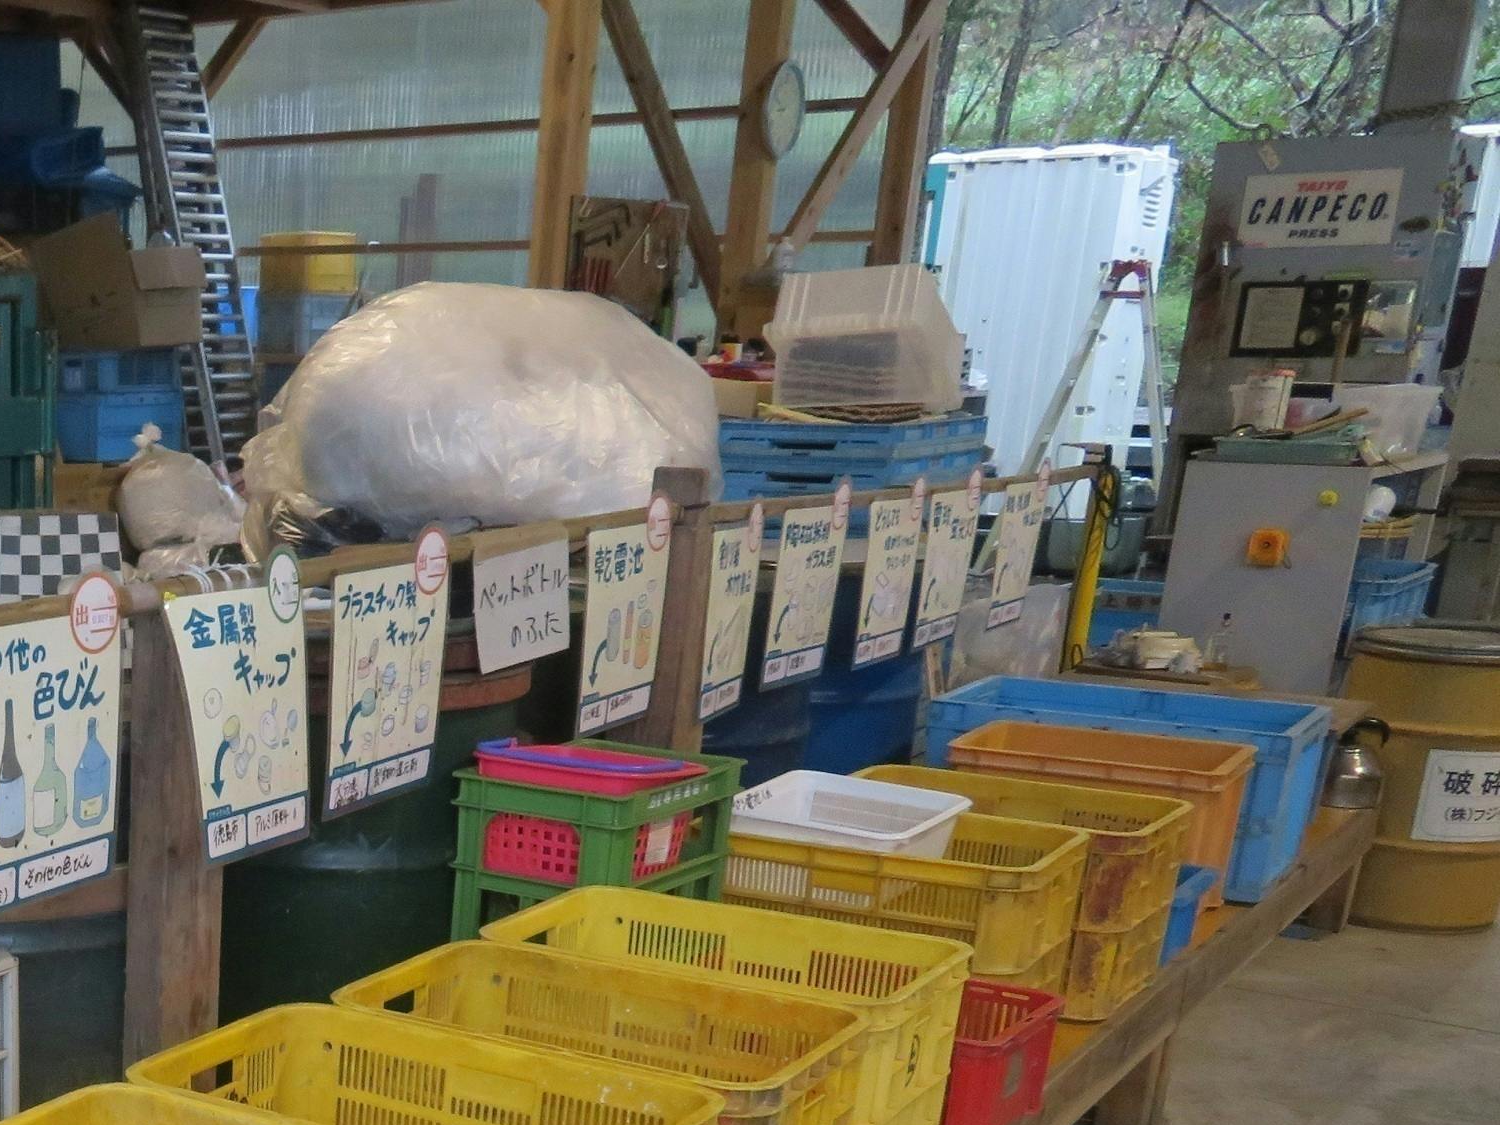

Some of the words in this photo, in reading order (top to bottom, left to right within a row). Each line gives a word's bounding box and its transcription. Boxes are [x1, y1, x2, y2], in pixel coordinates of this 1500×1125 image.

[1247, 192, 1389, 224] CANPECO
[594, 542, 644, 583] 乾電池
[340, 580, 417, 620] プラスチック製
[479, 563, 568, 609] ペットボトル
[183, 602, 257, 649] 金属製
[386, 608, 436, 647] キャップ
[511, 611, 563, 648] のふた
[33, 657, 106, 720] 色びん
[233, 647, 297, 695] キャップ
